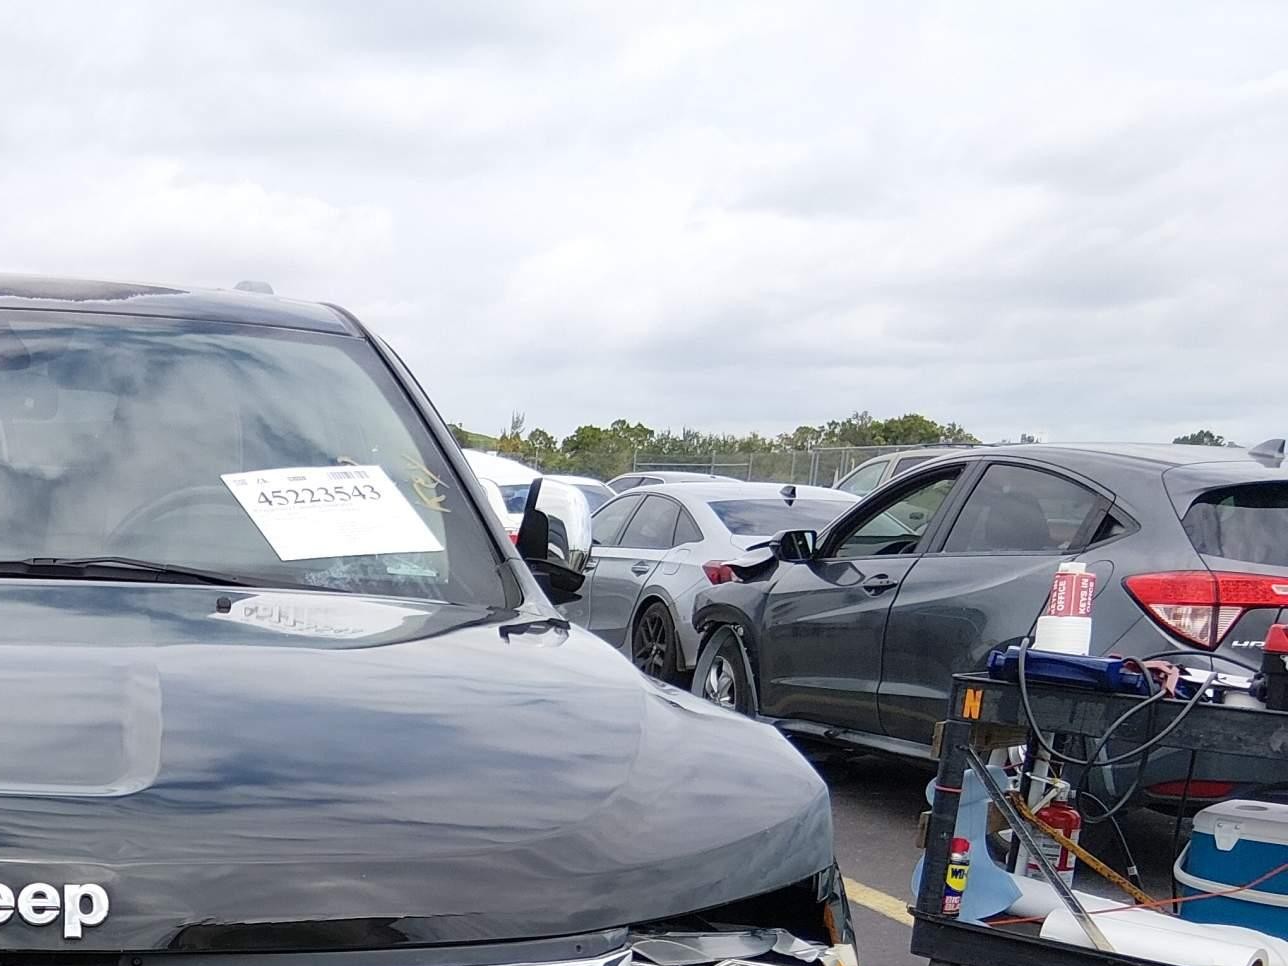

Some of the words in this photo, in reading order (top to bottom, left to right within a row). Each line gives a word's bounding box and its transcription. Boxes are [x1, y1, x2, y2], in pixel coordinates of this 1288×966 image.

[257, 484, 382, 506] 45223543
[1081, 578, 1089, 588] IN
[1056, 580, 1066, 611] OFFICE
[1078, 590, 1088, 614] KEYS
[963, 688, 982, 720] N
